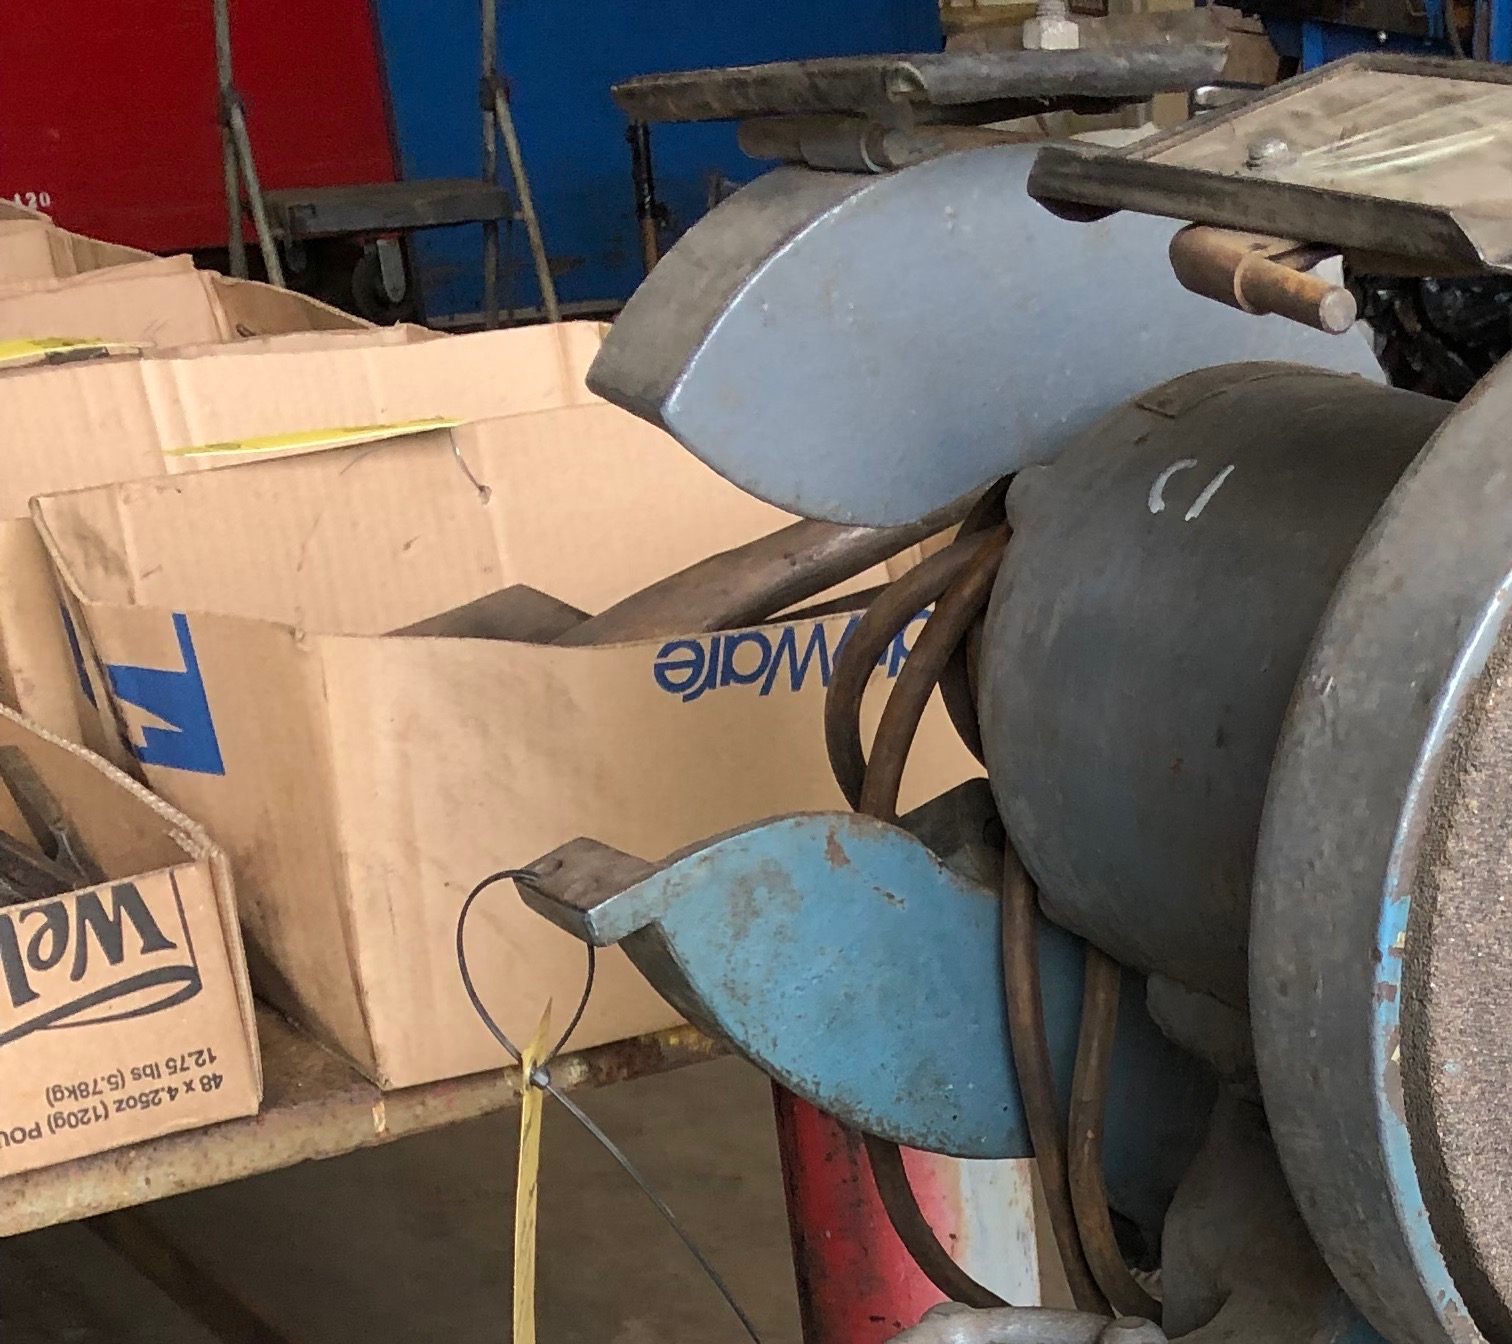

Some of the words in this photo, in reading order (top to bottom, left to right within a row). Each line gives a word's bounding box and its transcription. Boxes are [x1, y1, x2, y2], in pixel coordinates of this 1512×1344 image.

[166, 1046, 217, 1071] 12.75
[131, 1061, 162, 1082] lbs
[199, 1072, 223, 1093] 48
[45, 1068, 126, 1101] (5.78kg)
[183, 1081, 196, 1093] x
[115, 1083, 179, 1113] 4.25oz
[47, 1101, 110, 1135] (120g)
